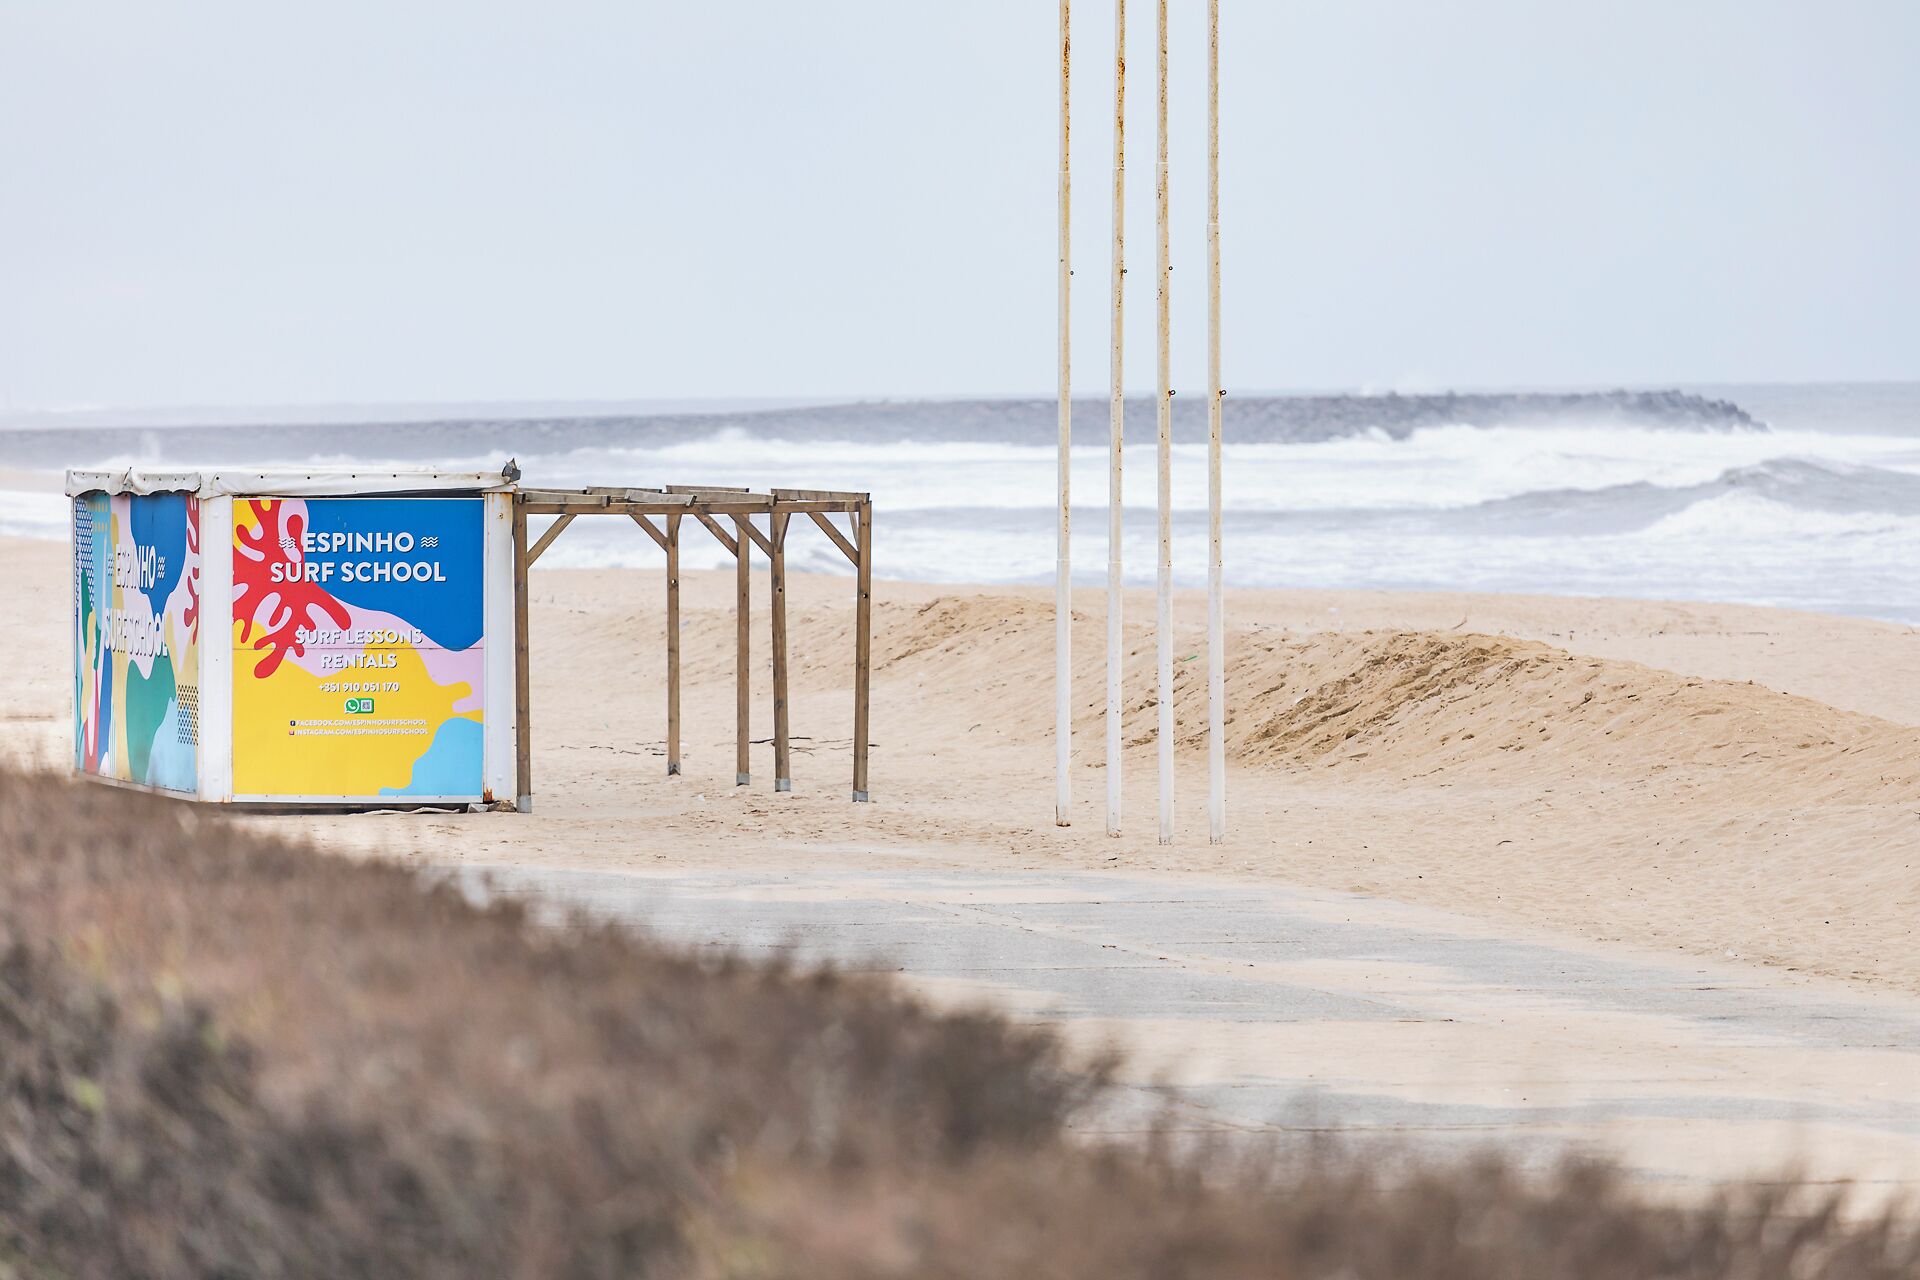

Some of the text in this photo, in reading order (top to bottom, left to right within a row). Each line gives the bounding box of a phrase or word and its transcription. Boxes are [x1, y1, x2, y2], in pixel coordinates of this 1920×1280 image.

[302, 532, 415, 553] ESPINHO
[116, 544, 157, 590] ESPINHO
[270, 562, 447, 582] SURF SCHOOL
[104, 608, 168, 658] SURF SCHOOL
[295, 629, 423, 645] SURF LESSONS
[322, 654, 398, 669] RENTALS
[319, 682, 400, 692] +351 910 051 170
[297, 719, 428, 727] FACEBOOK.COM/ESPINHOSURFSCHOOL
[296, 728, 429, 736] INSTAGRAM.COM/ESPINHOSURFSCHOOL
